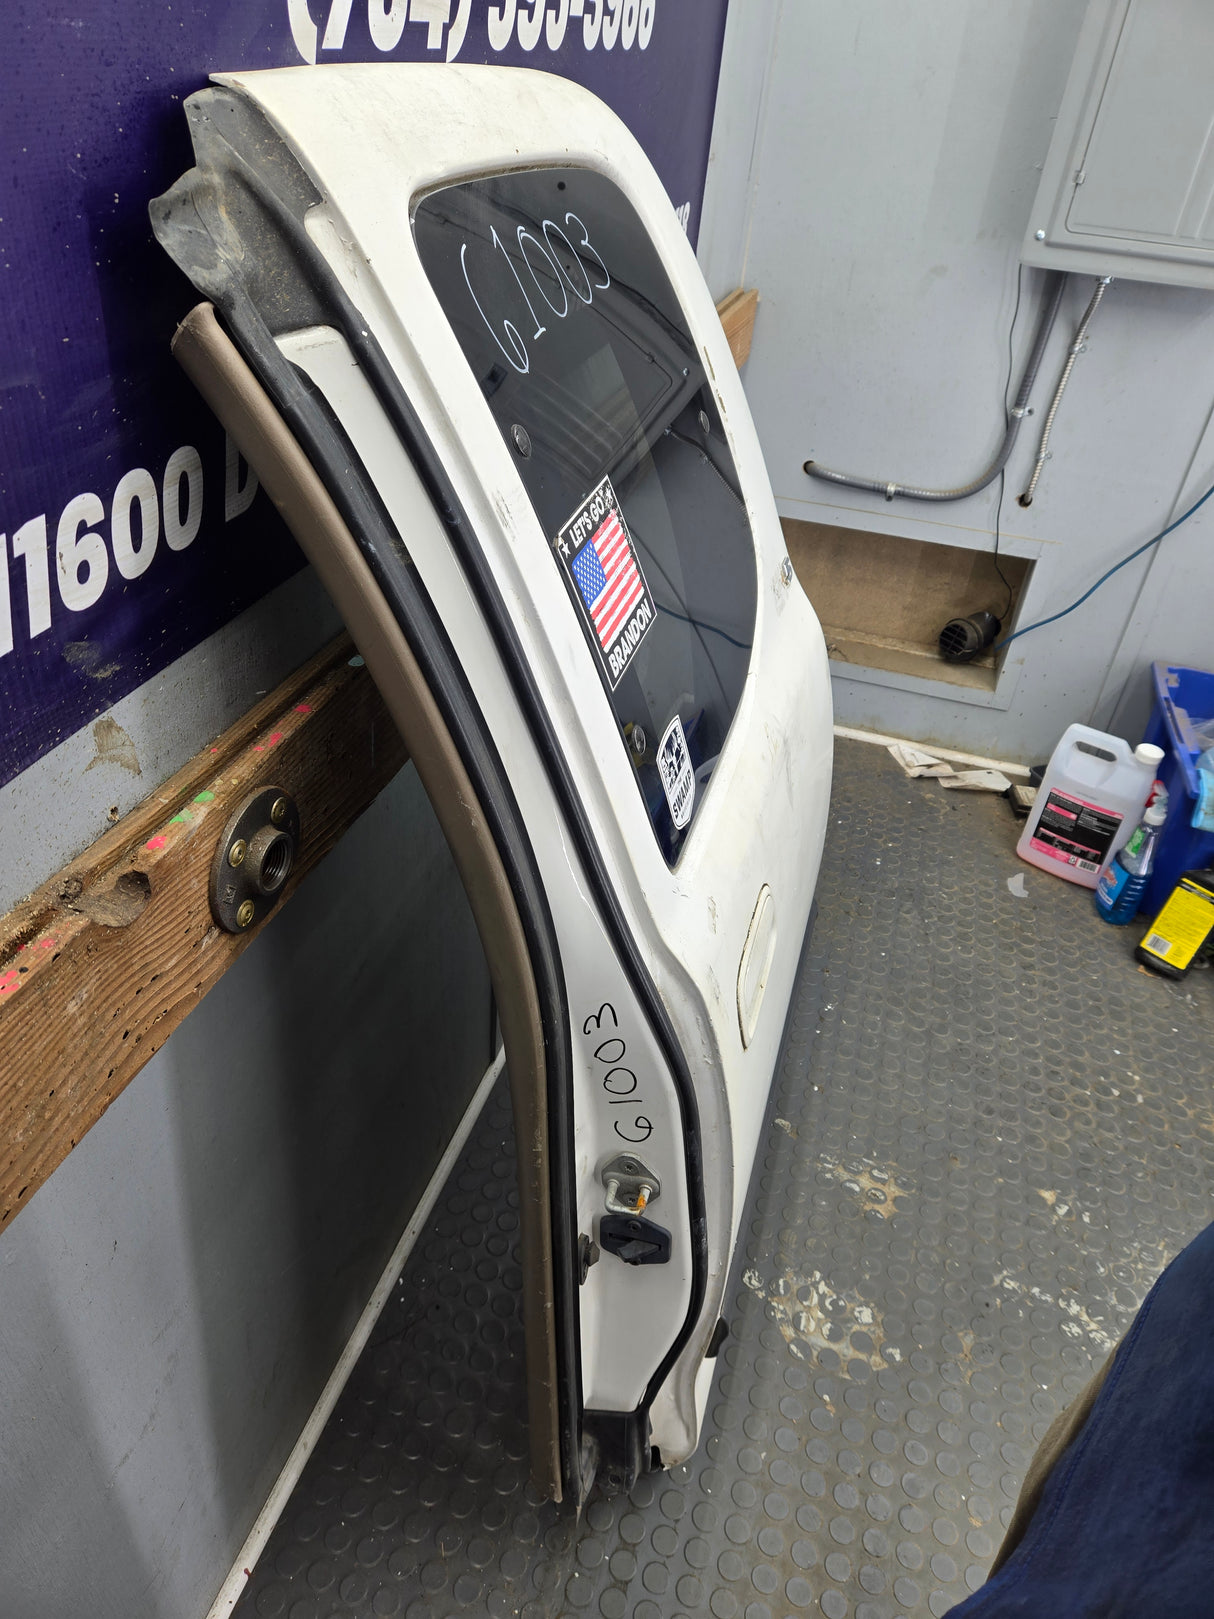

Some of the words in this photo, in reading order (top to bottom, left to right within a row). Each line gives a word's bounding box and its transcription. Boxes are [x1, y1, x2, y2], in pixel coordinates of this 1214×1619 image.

[569, 511, 593, 549] LET'S
[608, 597, 652, 679] BRANDON
[673, 769, 692, 819] SWAMP
